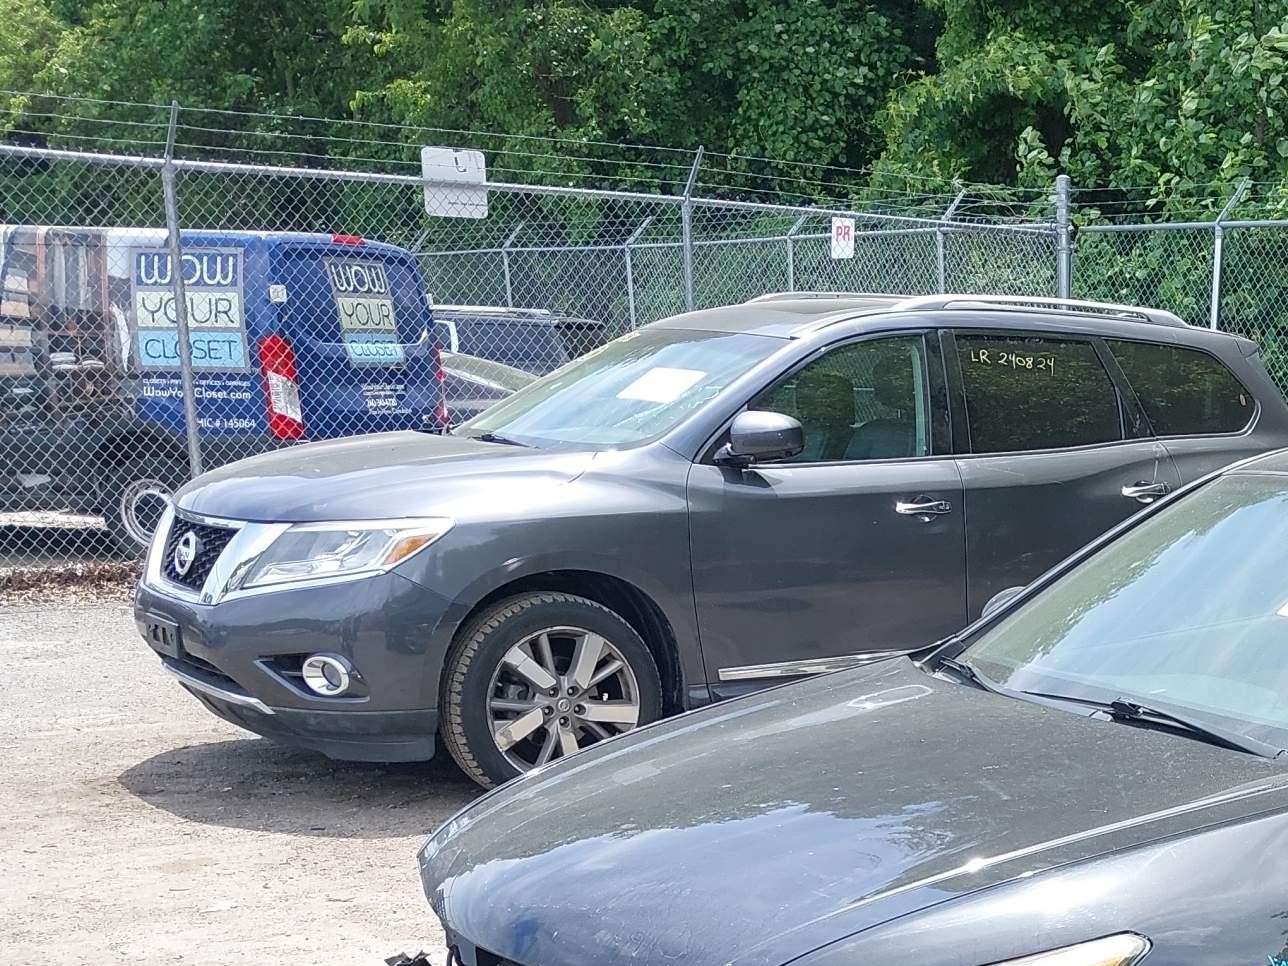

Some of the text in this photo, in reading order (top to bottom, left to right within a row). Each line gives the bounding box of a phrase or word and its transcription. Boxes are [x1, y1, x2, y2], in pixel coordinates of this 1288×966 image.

[836, 225, 851, 241] PR
[140, 254, 234, 286] WOW
[330, 264, 386, 293] WOW
[341, 302, 393, 327] YOUR
[349, 340, 398, 357] CLOSET
[971, 349, 991, 364] LR
[142, 386, 252, 399] WowYoCloset.com
